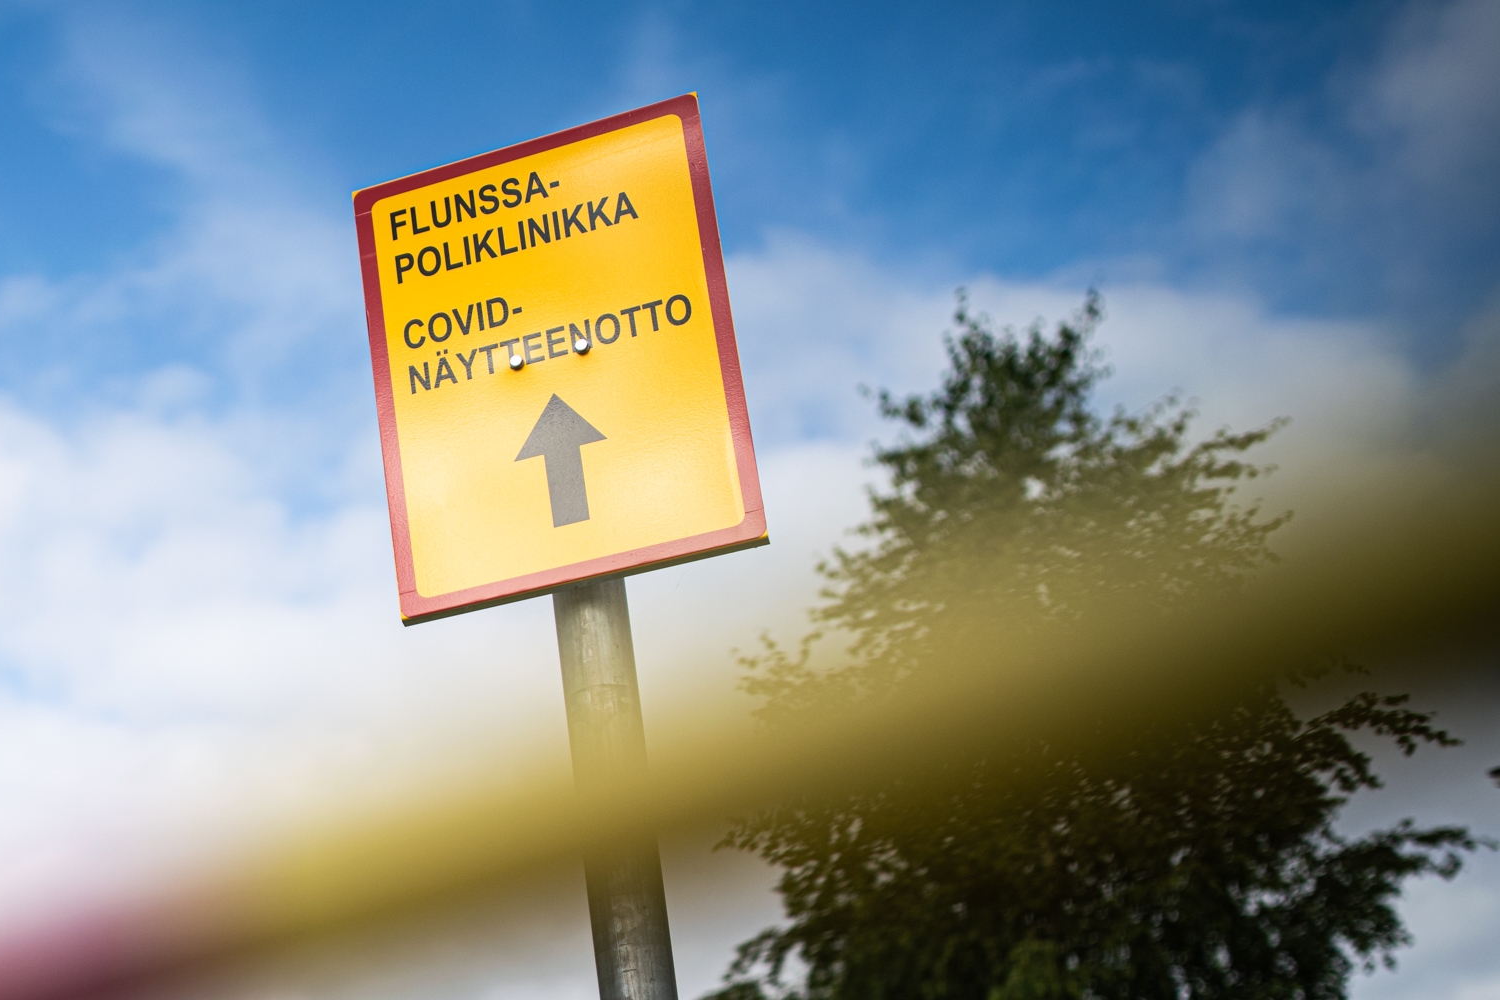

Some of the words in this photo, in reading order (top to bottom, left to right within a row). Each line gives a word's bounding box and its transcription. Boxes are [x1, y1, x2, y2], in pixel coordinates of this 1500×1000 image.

[389, 171, 560, 241] FLUNSSA-
[394, 191, 639, 284] POLIKLINIKKA
[403, 296, 523, 349] COVID-
[408, 293, 692, 395] NÄYTTEENOTTO
